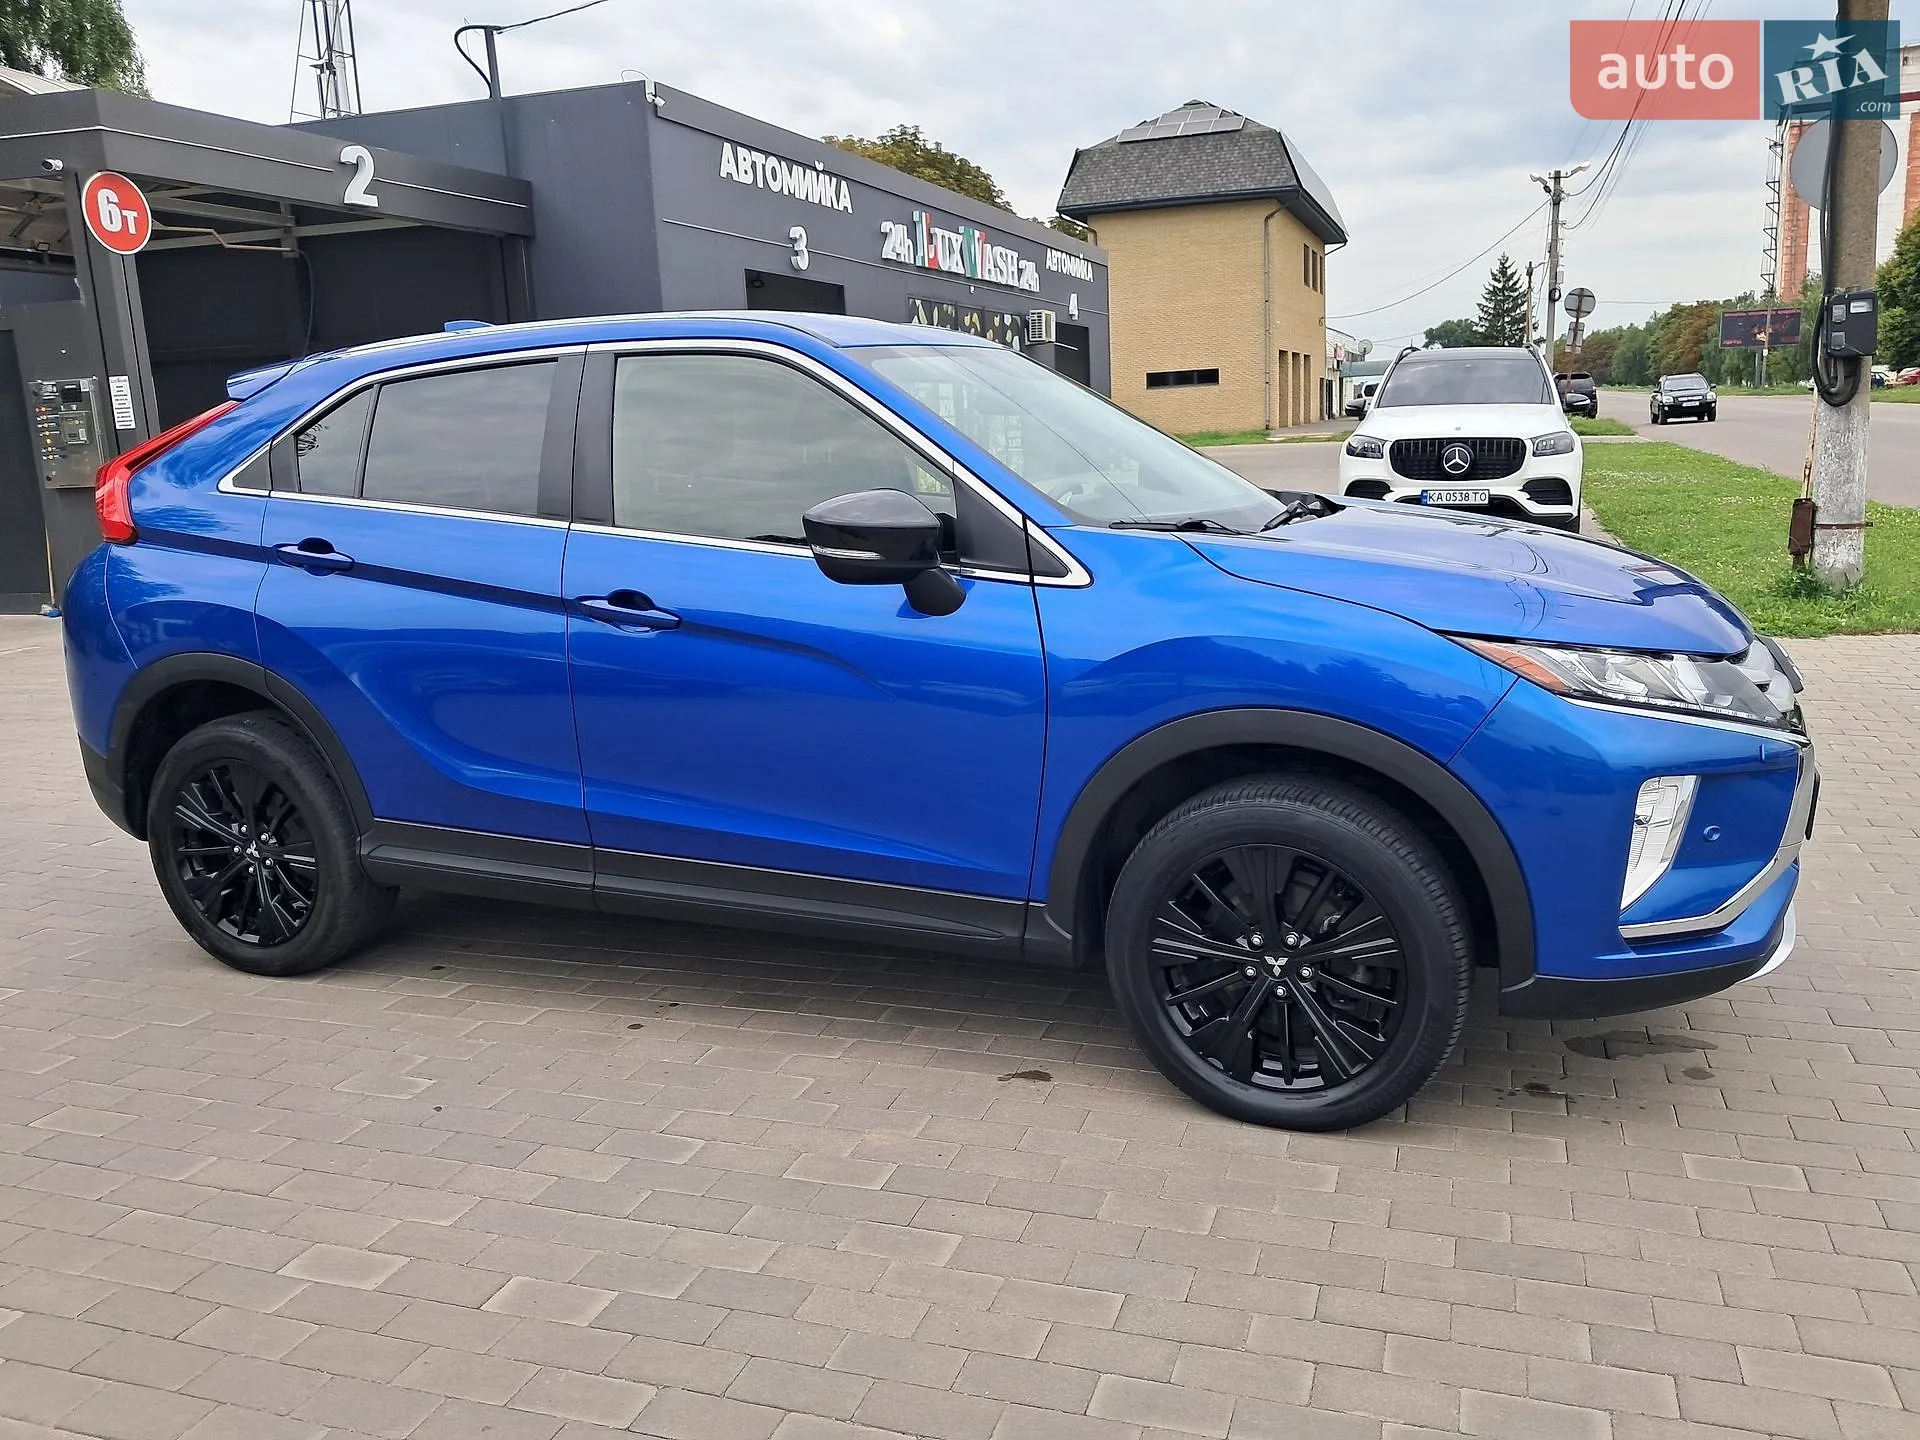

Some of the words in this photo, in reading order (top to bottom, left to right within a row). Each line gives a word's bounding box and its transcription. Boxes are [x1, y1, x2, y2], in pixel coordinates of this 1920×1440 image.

[339, 145, 379, 208] 2
[719, 141, 853, 214] АВТОМИЙКА
[789, 226, 810, 271] 3
[1046, 247, 1094, 283] АВТОМИЙКА
[1068, 293, 1079, 320] 4
[1445, 491, 1470, 502] 0538
